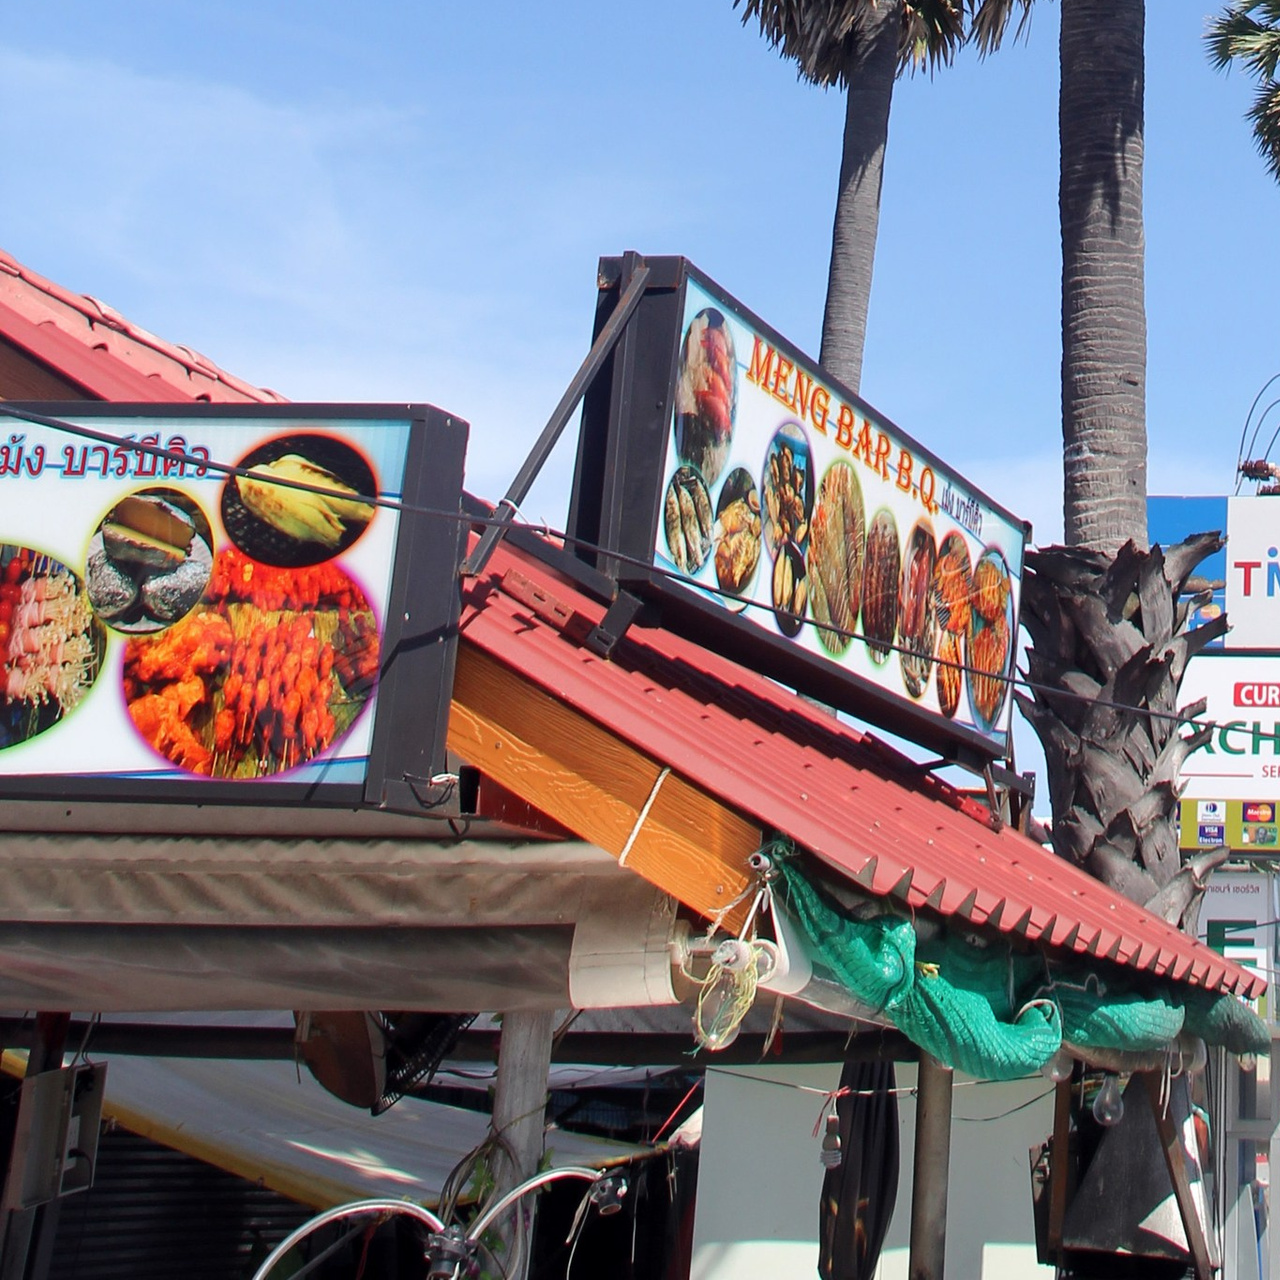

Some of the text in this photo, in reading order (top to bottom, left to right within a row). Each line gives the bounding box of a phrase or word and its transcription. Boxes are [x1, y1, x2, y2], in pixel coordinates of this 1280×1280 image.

[746, 333, 939, 515] MENG BAR B.Q.
[1204, 826, 1219, 834] VISA
